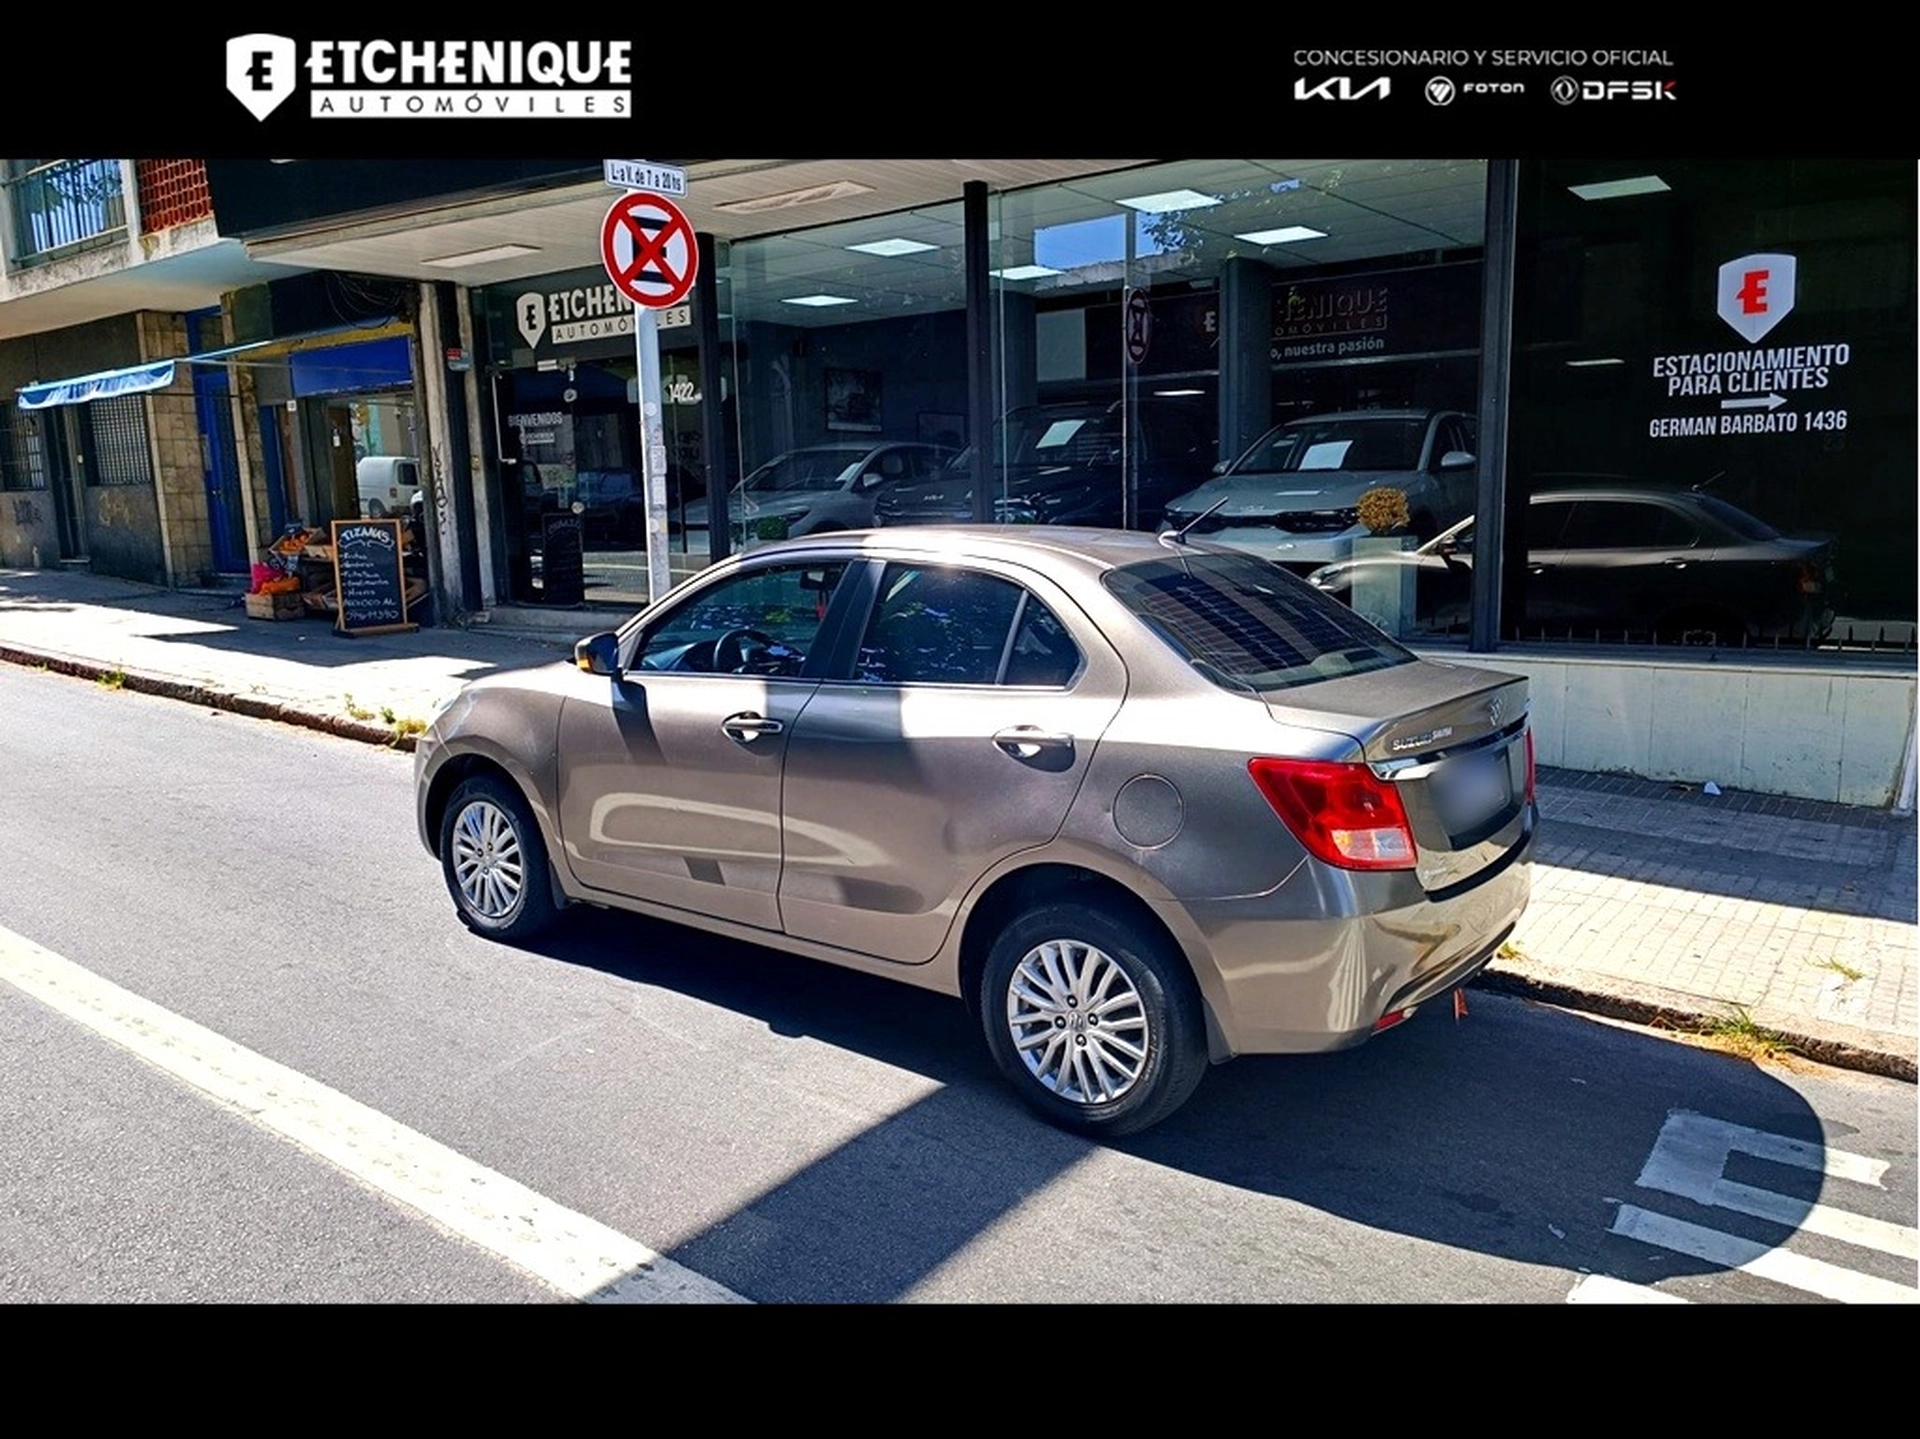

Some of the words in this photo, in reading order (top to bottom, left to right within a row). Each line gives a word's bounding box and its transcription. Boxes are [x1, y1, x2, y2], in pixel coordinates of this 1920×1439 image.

[555, 311, 687, 340] AUTOMÓES
[1284, 341, 1335, 357] nuestra
[1338, 336, 1385, 355] pasión
[1653, 343, 1850, 377] ESTACIONAMIENTO
[669, 382, 694, 403] 1422
[1668, 374, 1722, 396] PARA
[1728, 366, 1829, 393] CLIENTES
[1649, 416, 1717, 437] GERMAN
[1721, 412, 1798, 434] BARBATO
[1804, 410, 1848, 432] 1436
